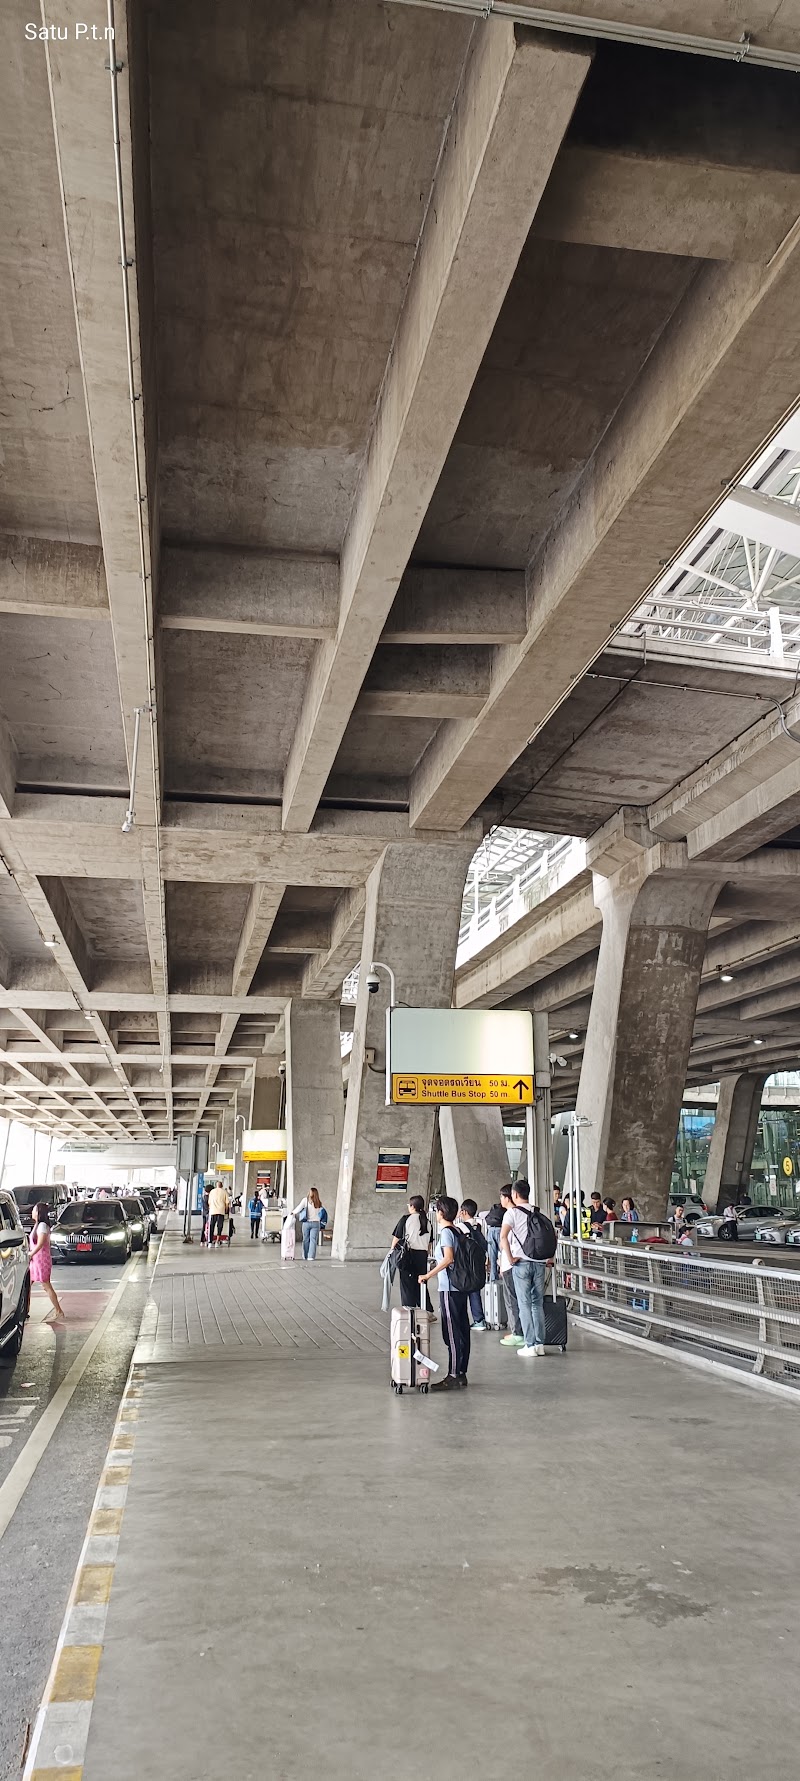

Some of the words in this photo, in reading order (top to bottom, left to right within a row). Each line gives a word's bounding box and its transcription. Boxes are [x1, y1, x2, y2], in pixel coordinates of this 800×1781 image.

[468, 1090, 487, 1099] Stop
[489, 1090, 499, 1098] 50
[785, 1160, 790, 1171] 5
